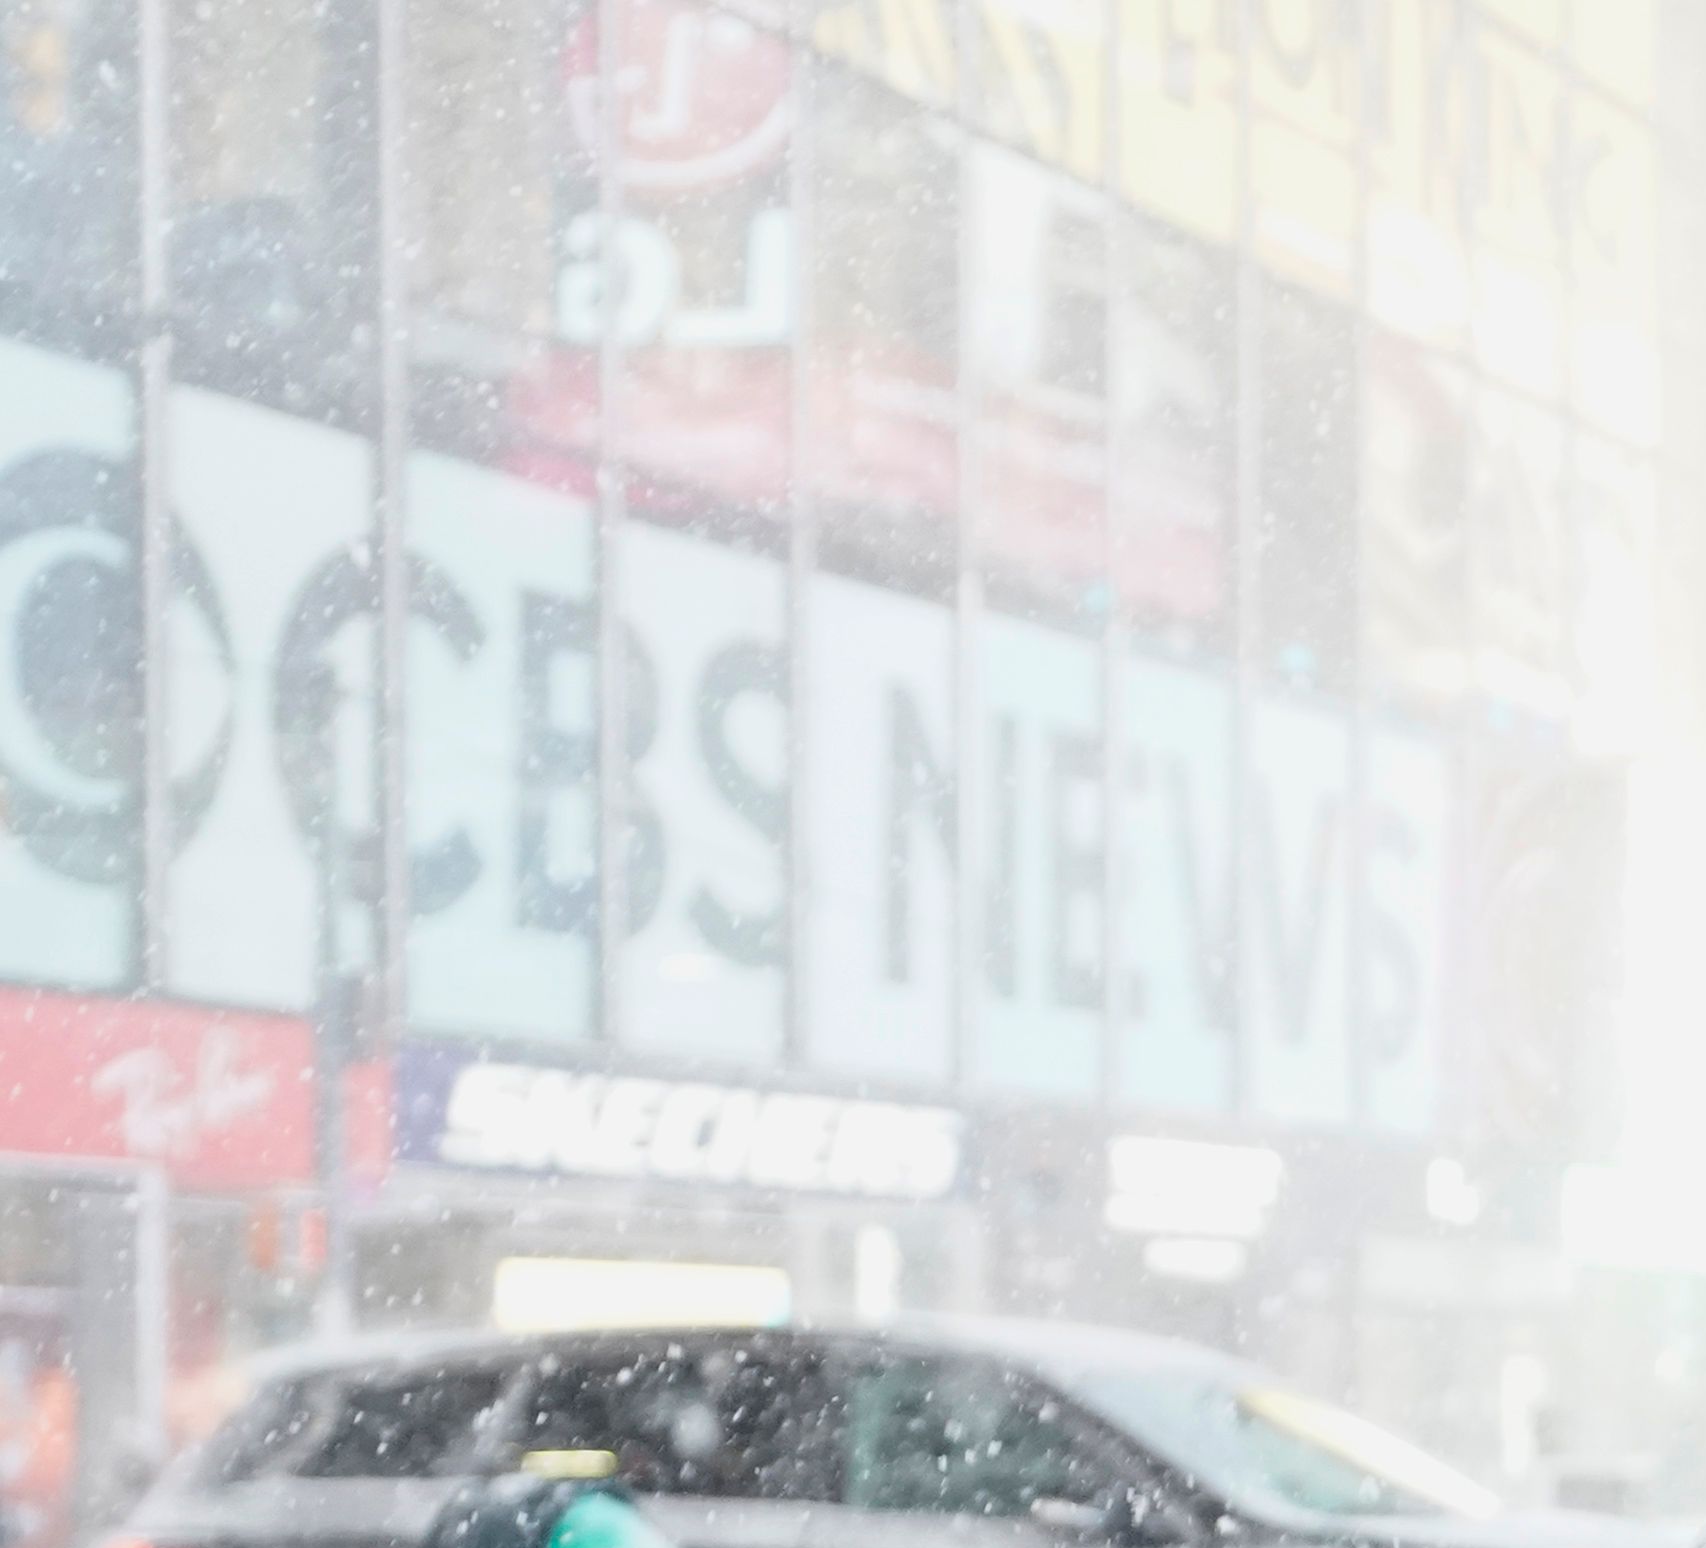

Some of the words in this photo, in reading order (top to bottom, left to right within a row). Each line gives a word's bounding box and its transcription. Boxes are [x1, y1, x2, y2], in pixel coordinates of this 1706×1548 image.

[271, 540, 800, 963] CBS
[884, 684, 1420, 1062] NEWS
[441, 1061, 960, 1198] SKECHERS
